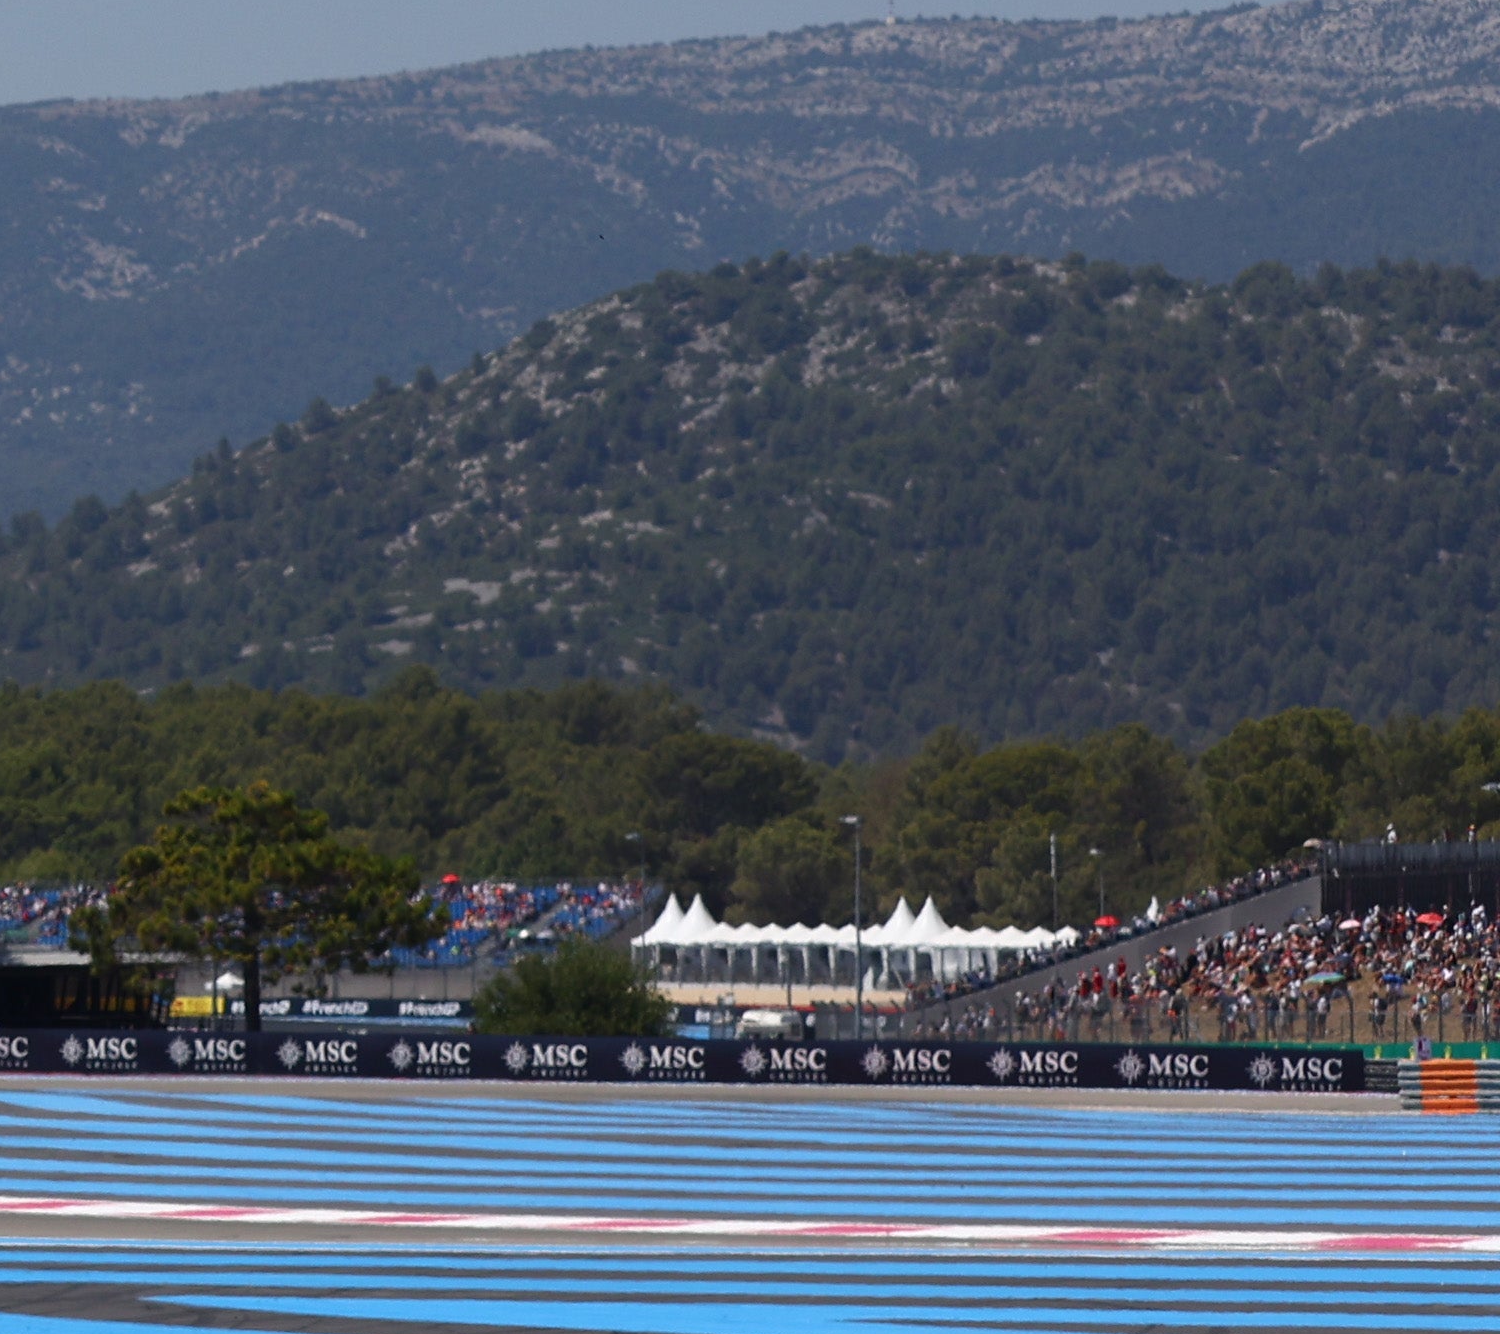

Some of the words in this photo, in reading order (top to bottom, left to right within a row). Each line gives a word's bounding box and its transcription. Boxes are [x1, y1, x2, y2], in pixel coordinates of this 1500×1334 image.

[87, 1038, 136, 1059] MSC
[195, 1039, 245, 1060] MSC
[306, 1041, 356, 1062] MSC
[418, 1042, 470, 1064] MSC
[533, 1044, 587, 1066] MSC
[650, 1046, 704, 1068] MSC
[771, 1048, 826, 1070] MSC
[893, 1049, 950, 1071] MSC
[1021, 1051, 1077, 1073] MSC
[1149, 1054, 1208, 1076] MSC
[1281, 1058, 1342, 1080] MSC
